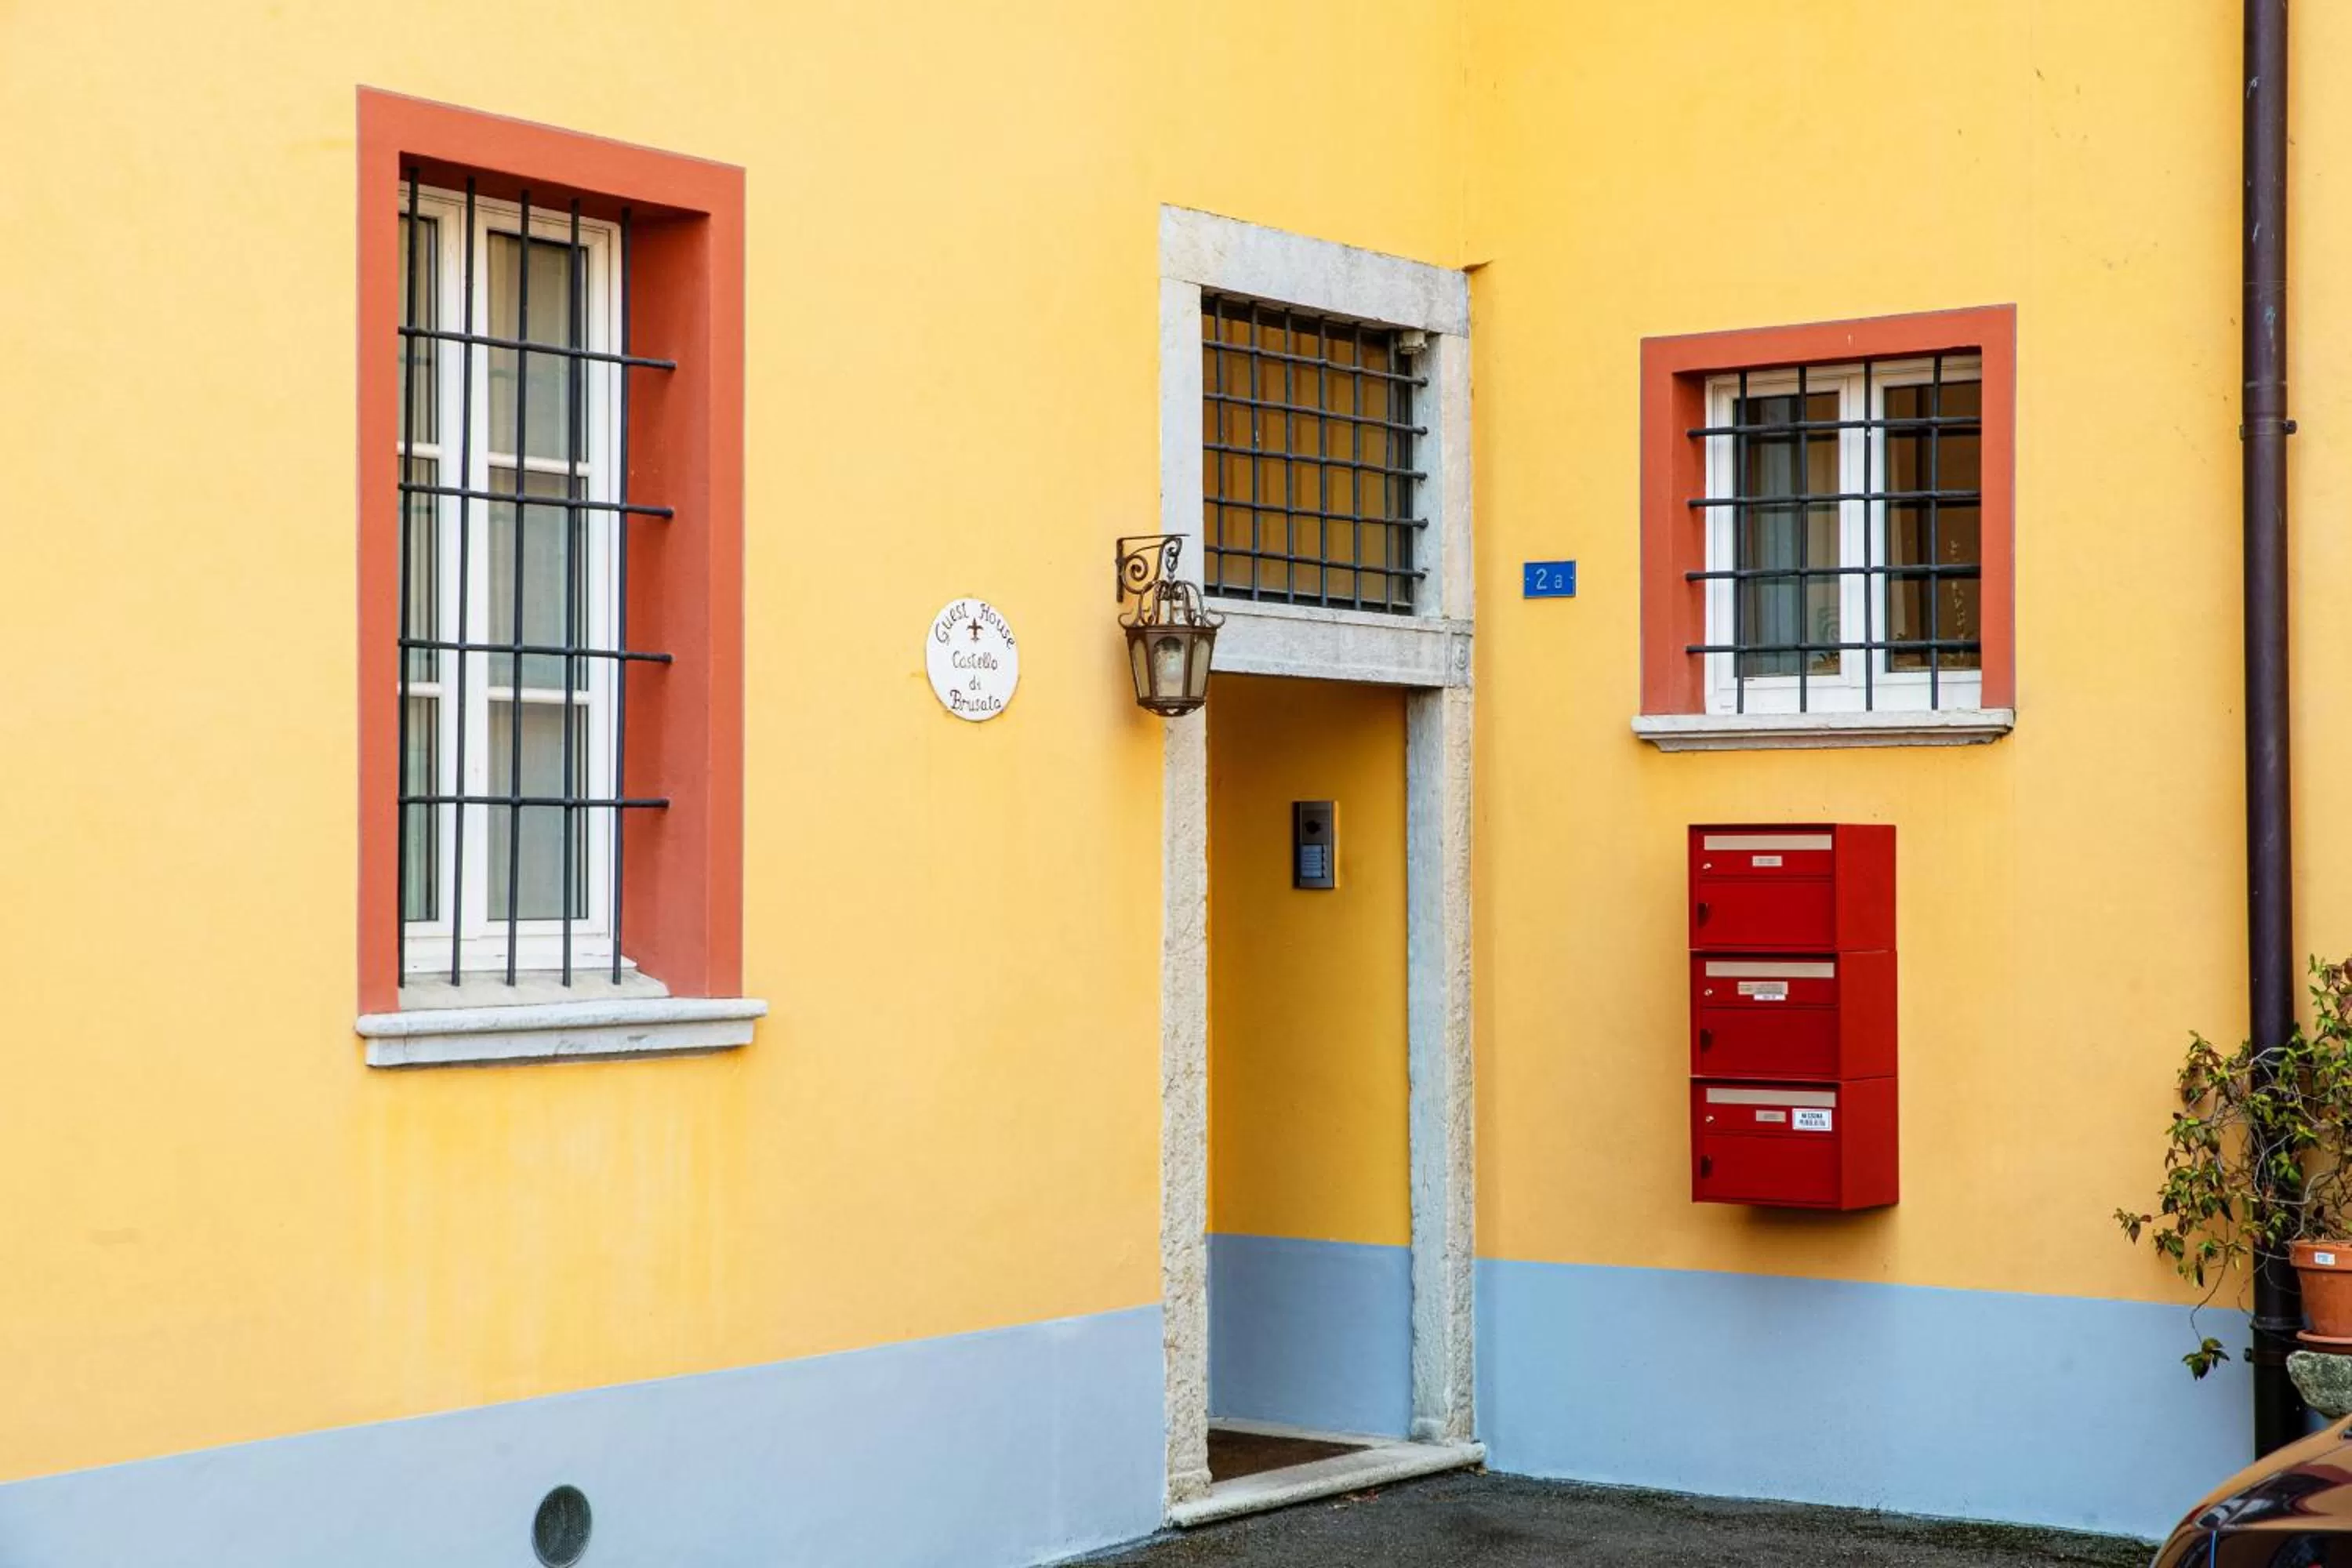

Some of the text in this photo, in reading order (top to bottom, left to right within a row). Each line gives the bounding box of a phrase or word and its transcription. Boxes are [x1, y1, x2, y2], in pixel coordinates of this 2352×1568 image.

[1535, 568, 1548, 590] 2
[935, 601, 1015, 650] Guest House
[952, 650, 998, 670] Castello
[969, 674, 982, 691] di
